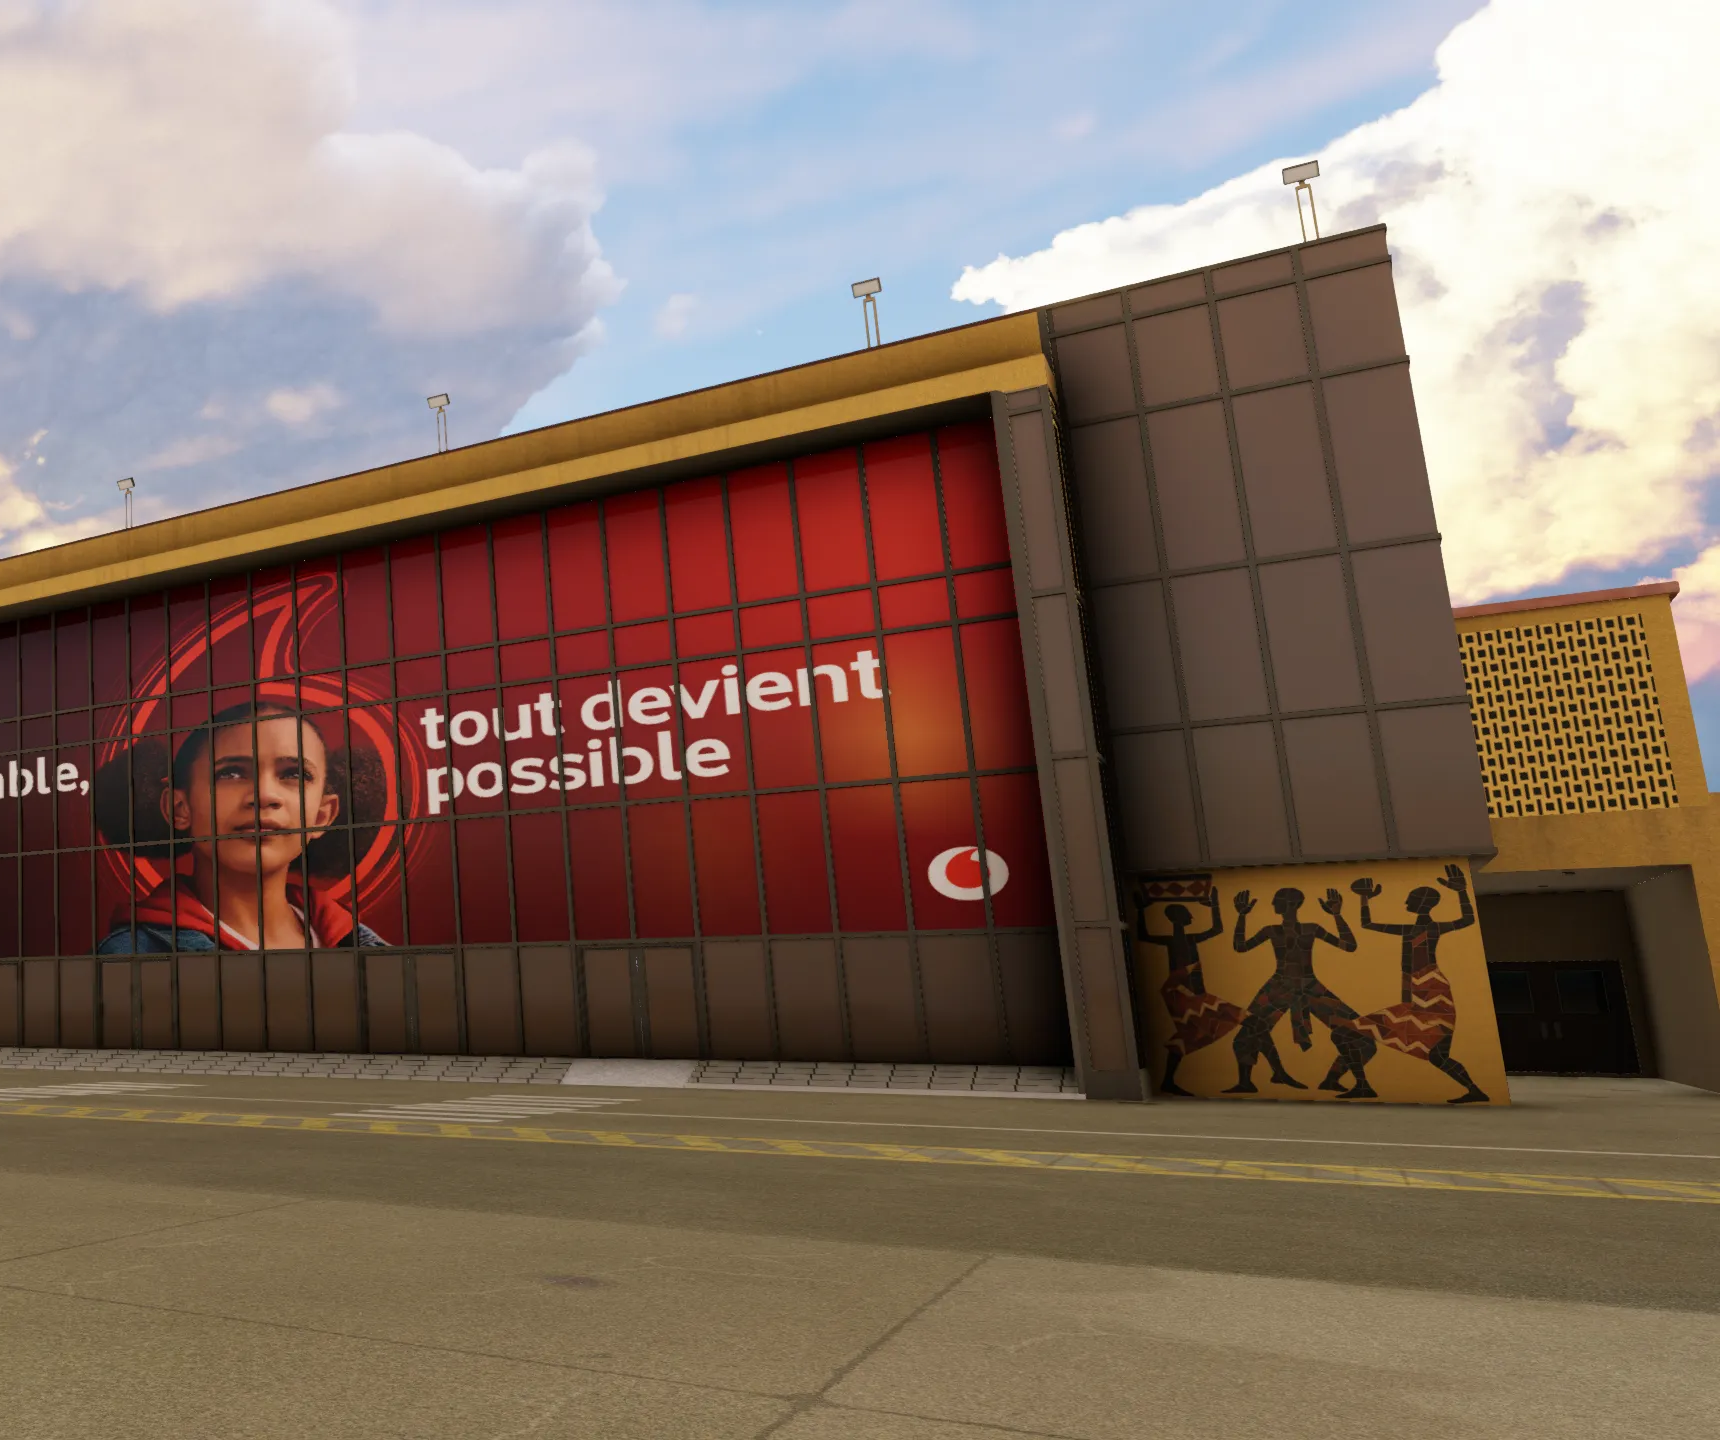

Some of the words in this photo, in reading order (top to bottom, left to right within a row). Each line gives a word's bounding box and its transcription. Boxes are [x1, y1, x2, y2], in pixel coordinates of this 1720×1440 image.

[420, 690, 566, 750] tout
[580, 650, 891, 731] devient
[426, 730, 732, 815] possible
